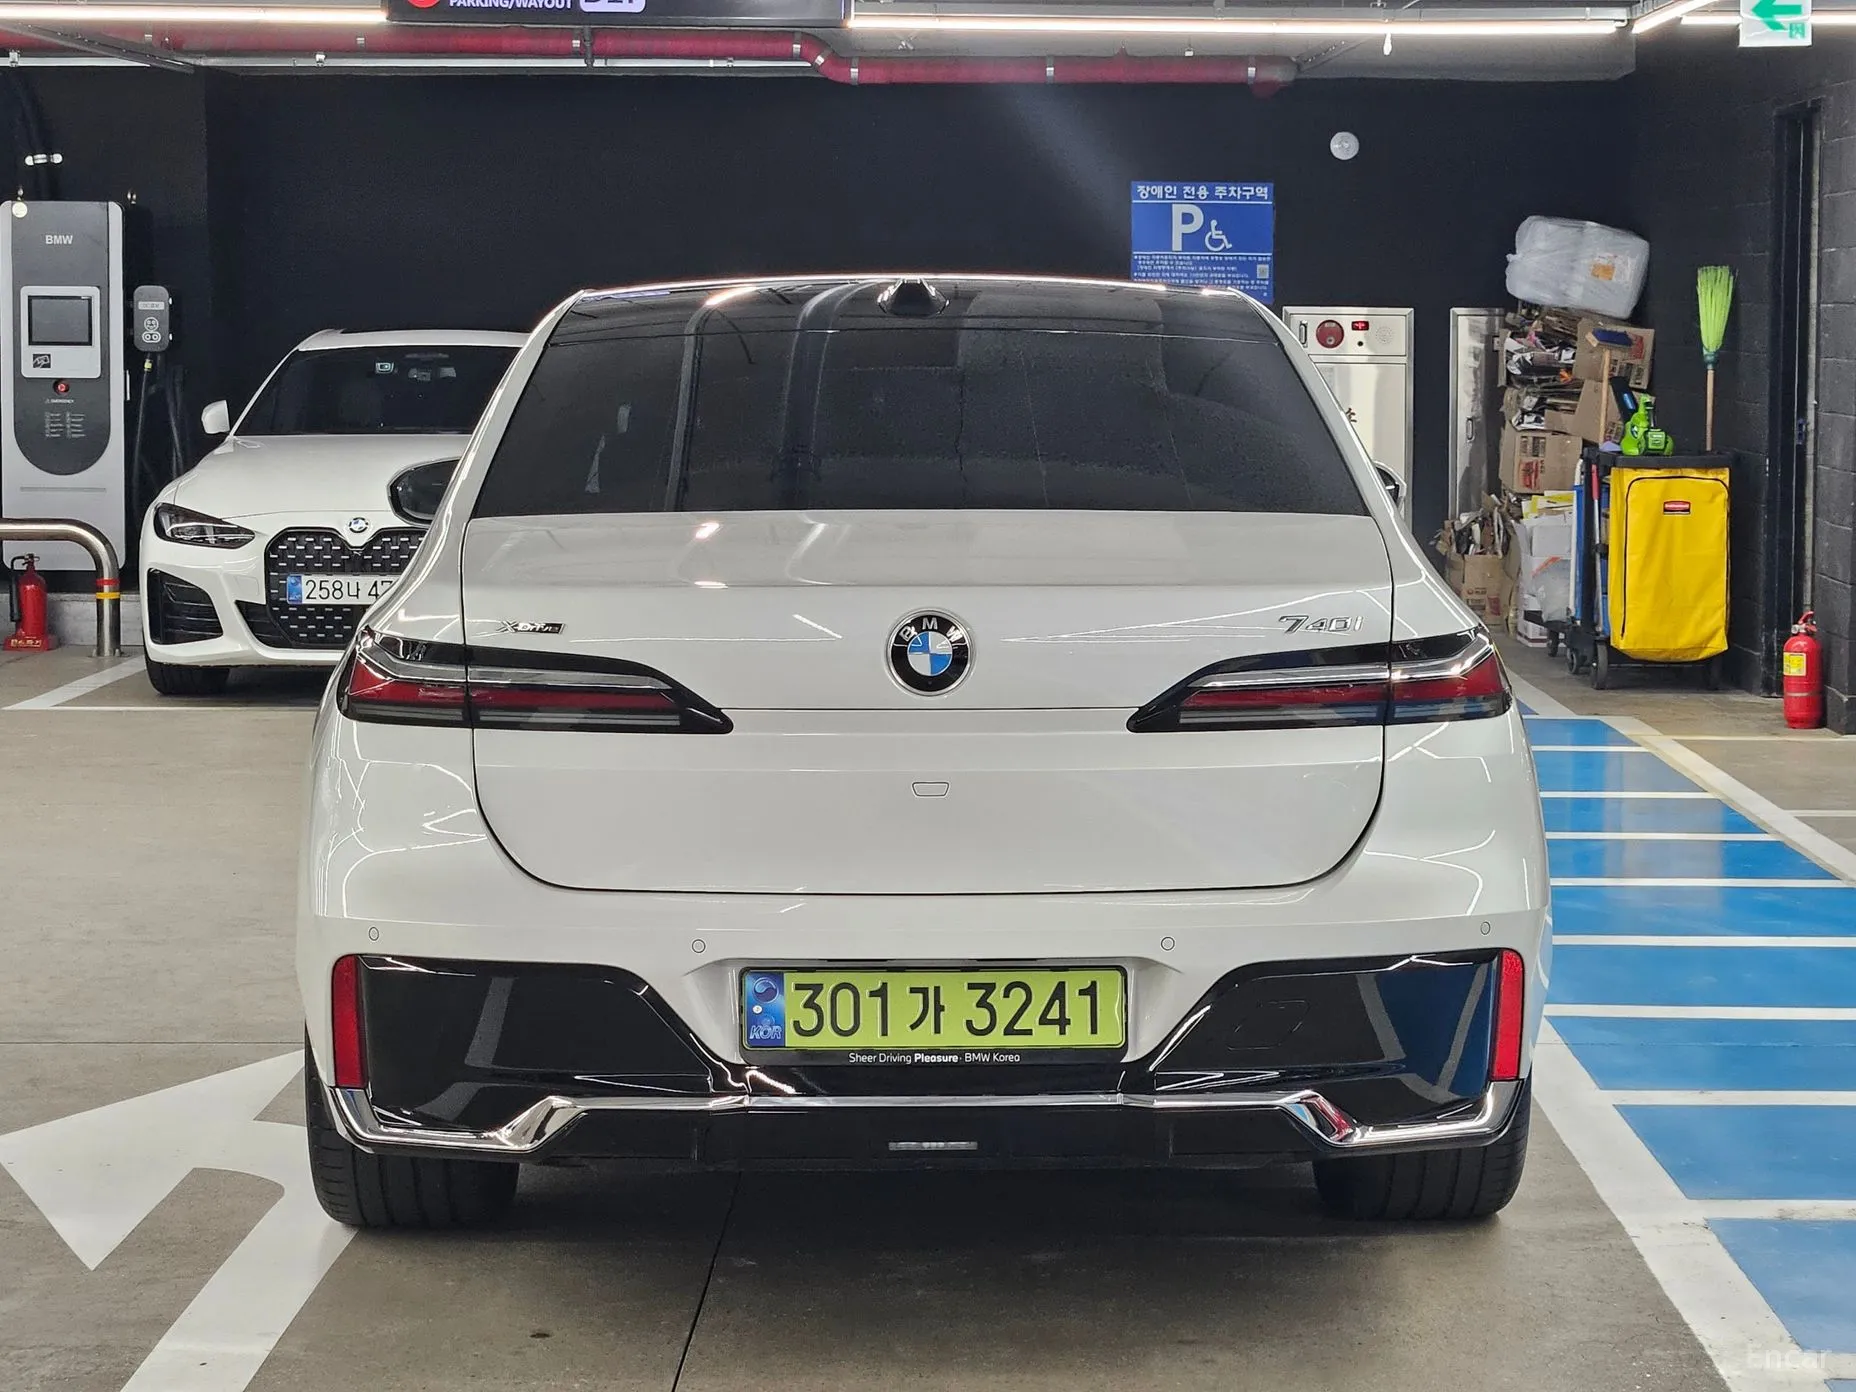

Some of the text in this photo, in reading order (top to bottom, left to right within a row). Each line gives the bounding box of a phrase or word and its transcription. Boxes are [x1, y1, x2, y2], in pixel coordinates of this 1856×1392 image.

[1137, 185, 1268, 199] 장애인 전용 주차구역
[1172, 203, 1204, 251] P
[45, 234, 73, 245] BMW
[305, 580, 361, 600] 258나
[899, 617, 963, 642] BMW
[1279, 615, 1363, 634] 740i
[965, 980, 1098, 1037] 3241
[750, 1024, 782, 1040] KOR
[849, 1053, 1020, 1064] Sheer Driving Pleasure BMW Korea
